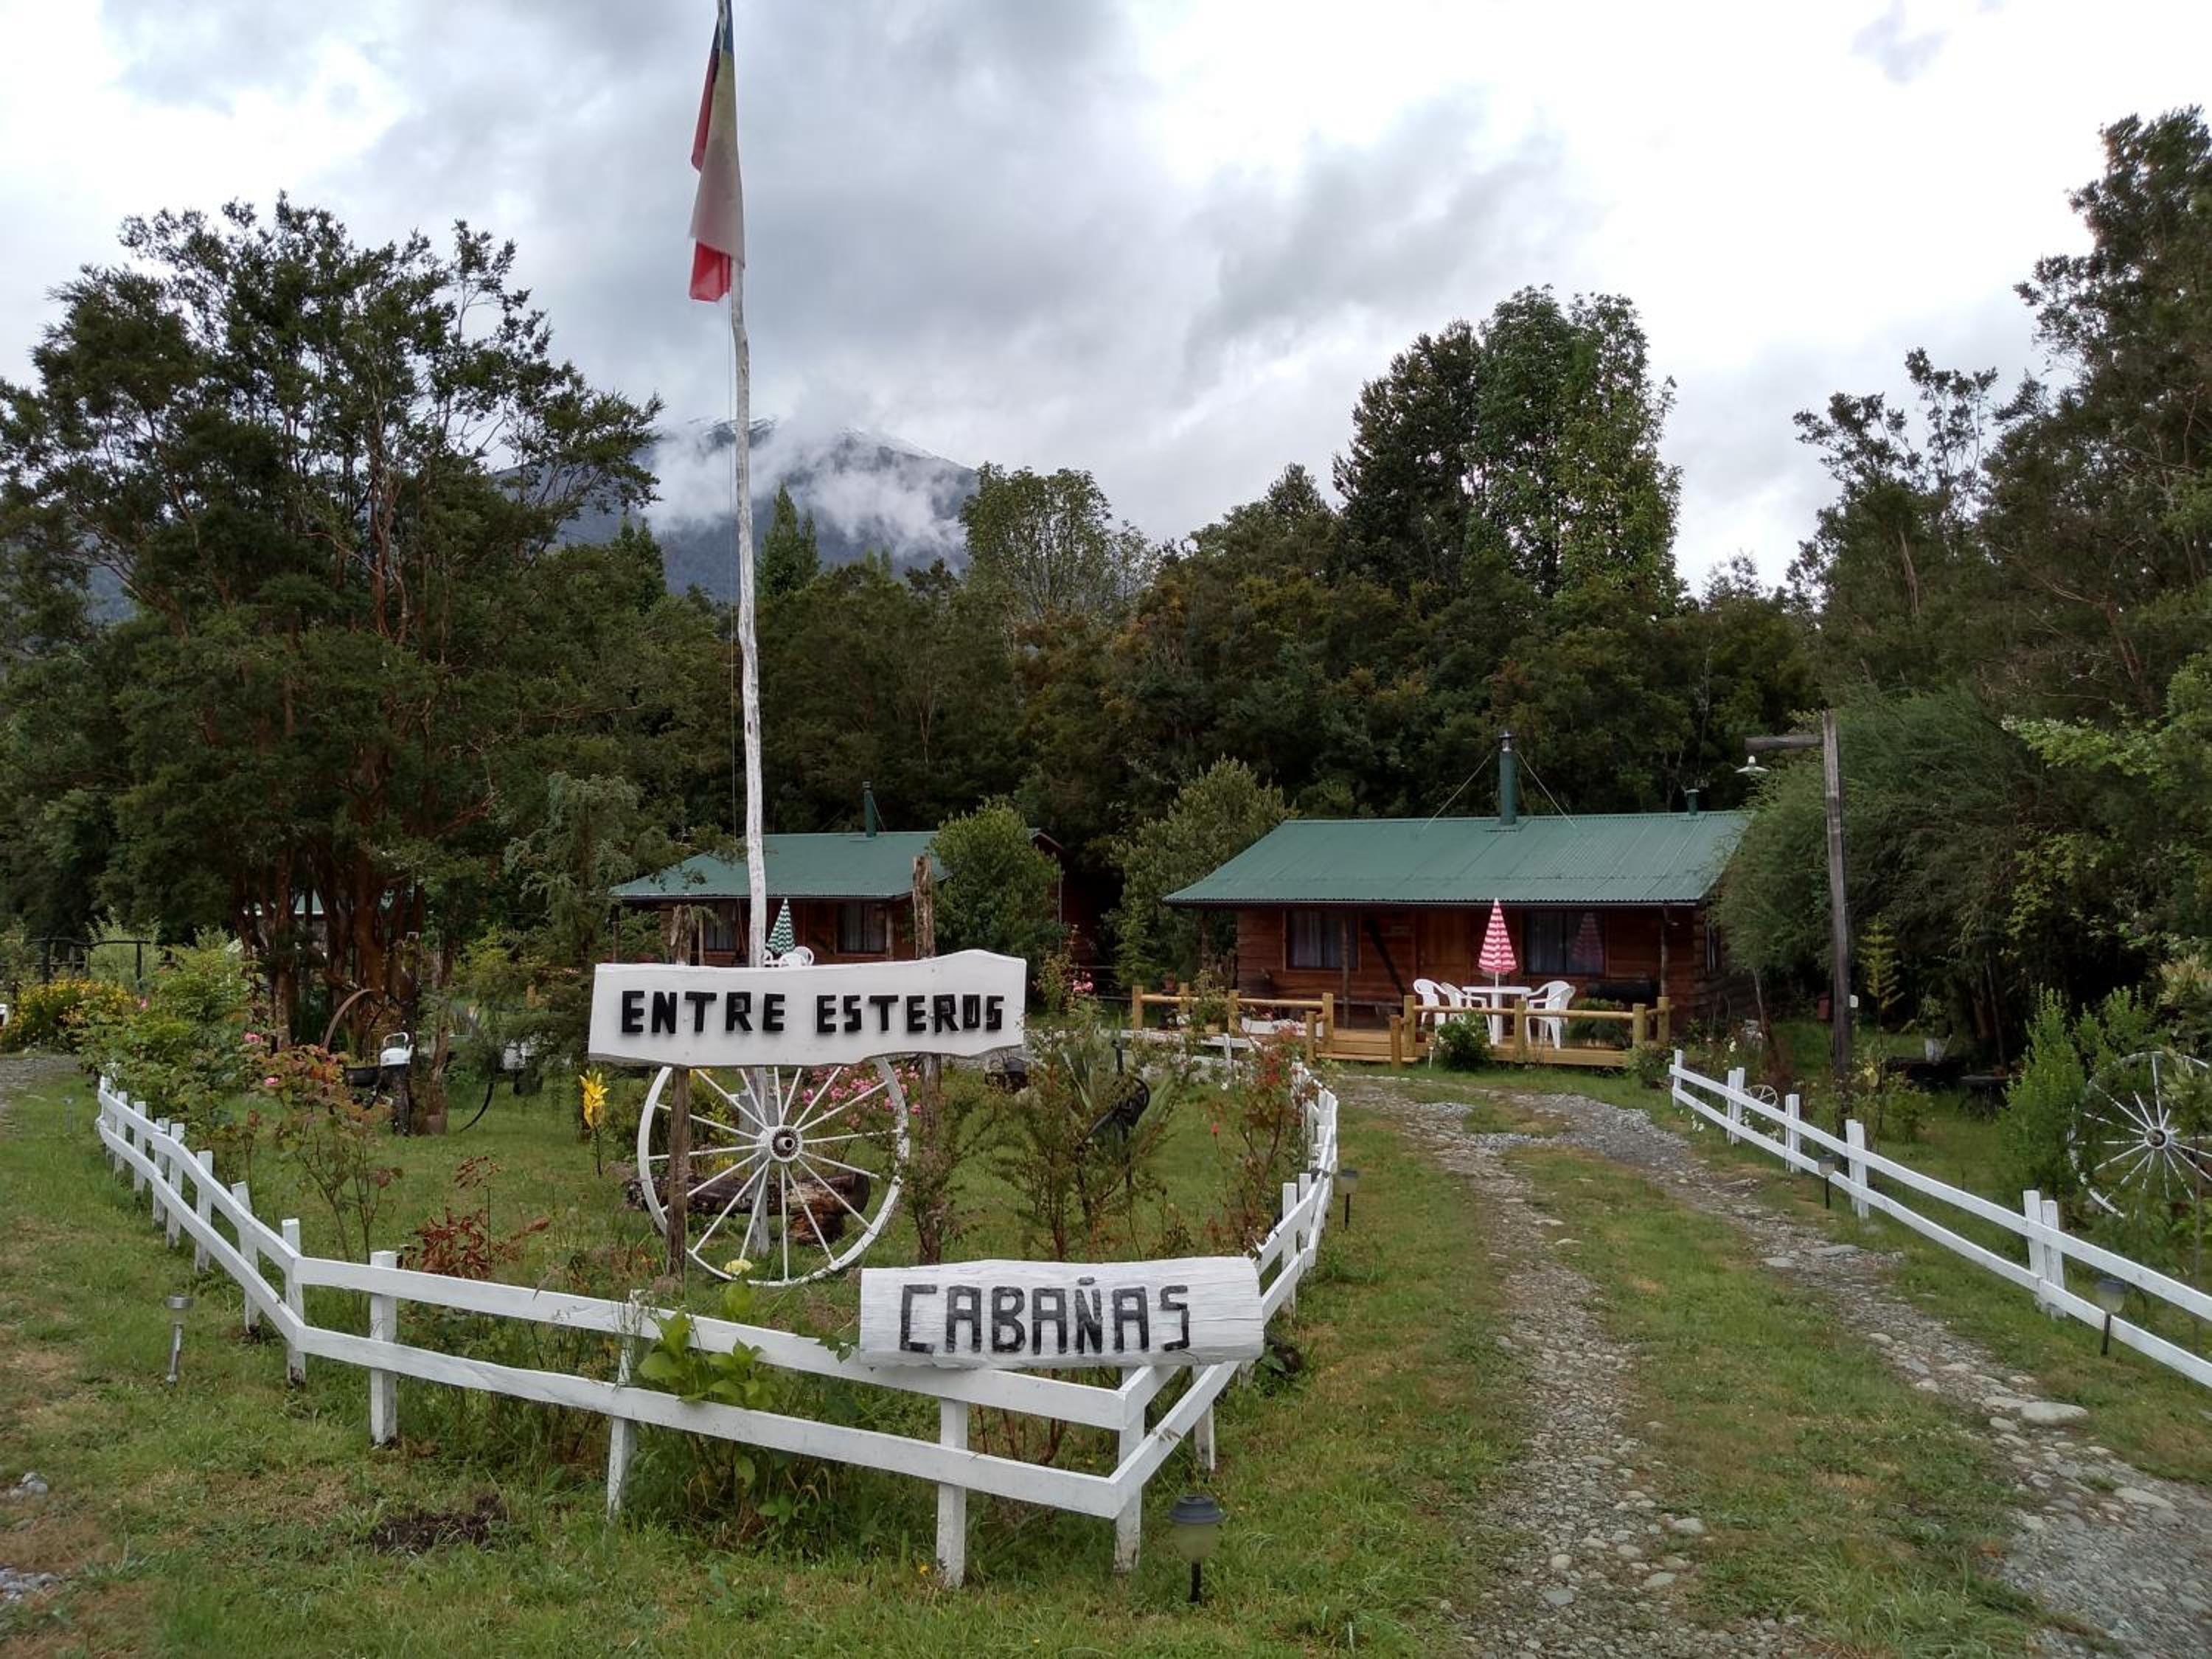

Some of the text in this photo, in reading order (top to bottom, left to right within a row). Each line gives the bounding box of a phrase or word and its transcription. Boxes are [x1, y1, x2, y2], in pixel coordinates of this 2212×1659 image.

[622, 991, 1004, 1034] ENTRE ESTEROS
[900, 1277, 1190, 1354] CABAÑAS
